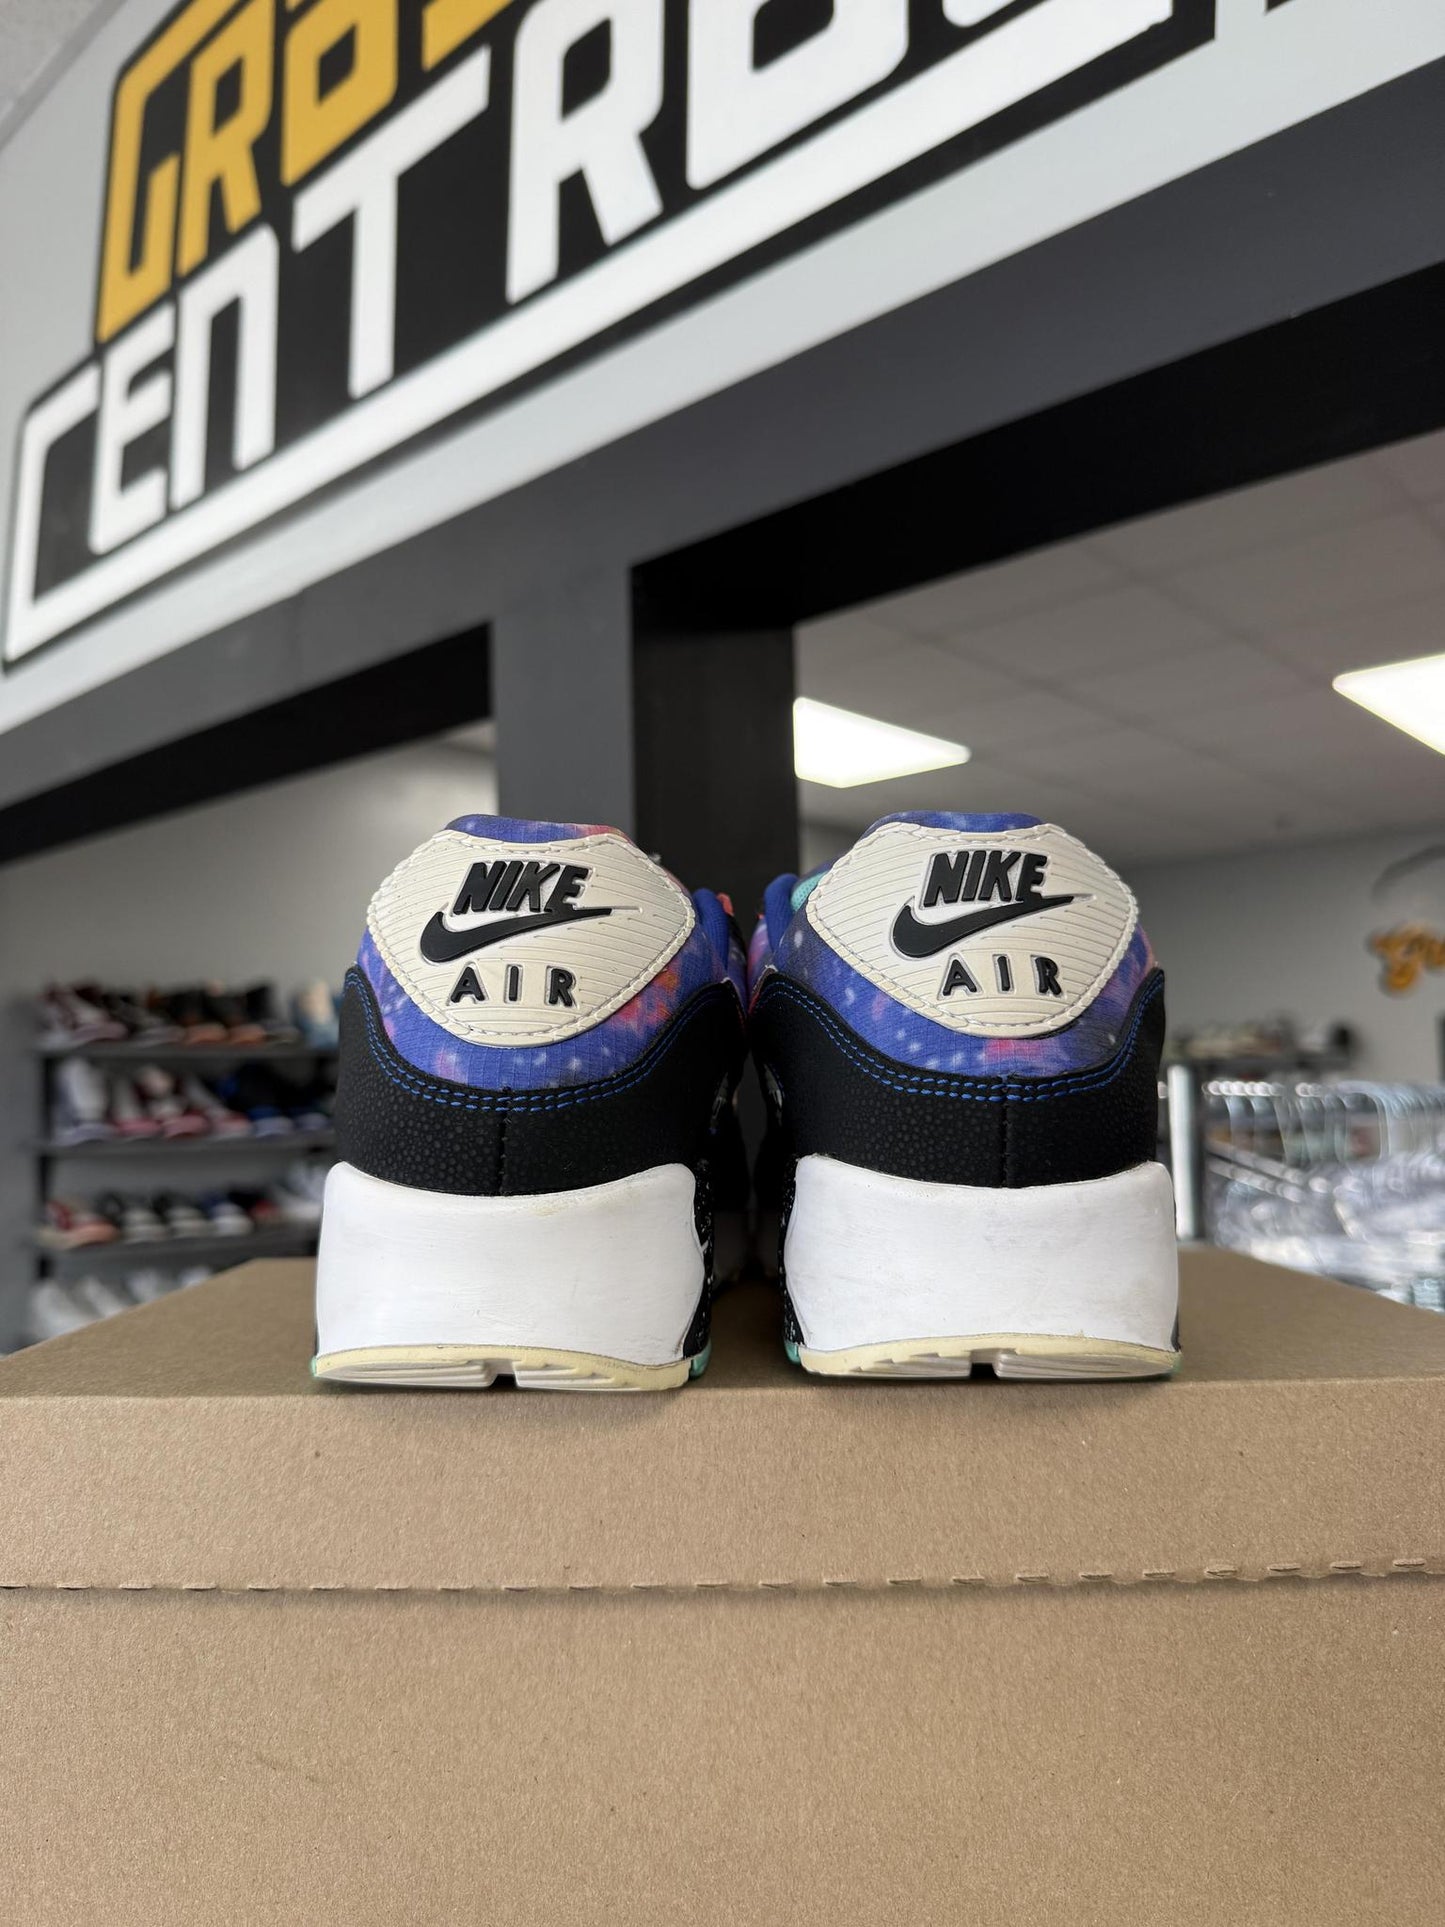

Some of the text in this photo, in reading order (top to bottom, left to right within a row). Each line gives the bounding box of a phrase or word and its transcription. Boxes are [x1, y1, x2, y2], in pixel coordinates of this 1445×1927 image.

[453, 861, 588, 914] NIKE
[923, 850, 1048, 907] NIKE
[450, 966, 576, 1007] AIR
[943, 956, 1062, 997] AIR
